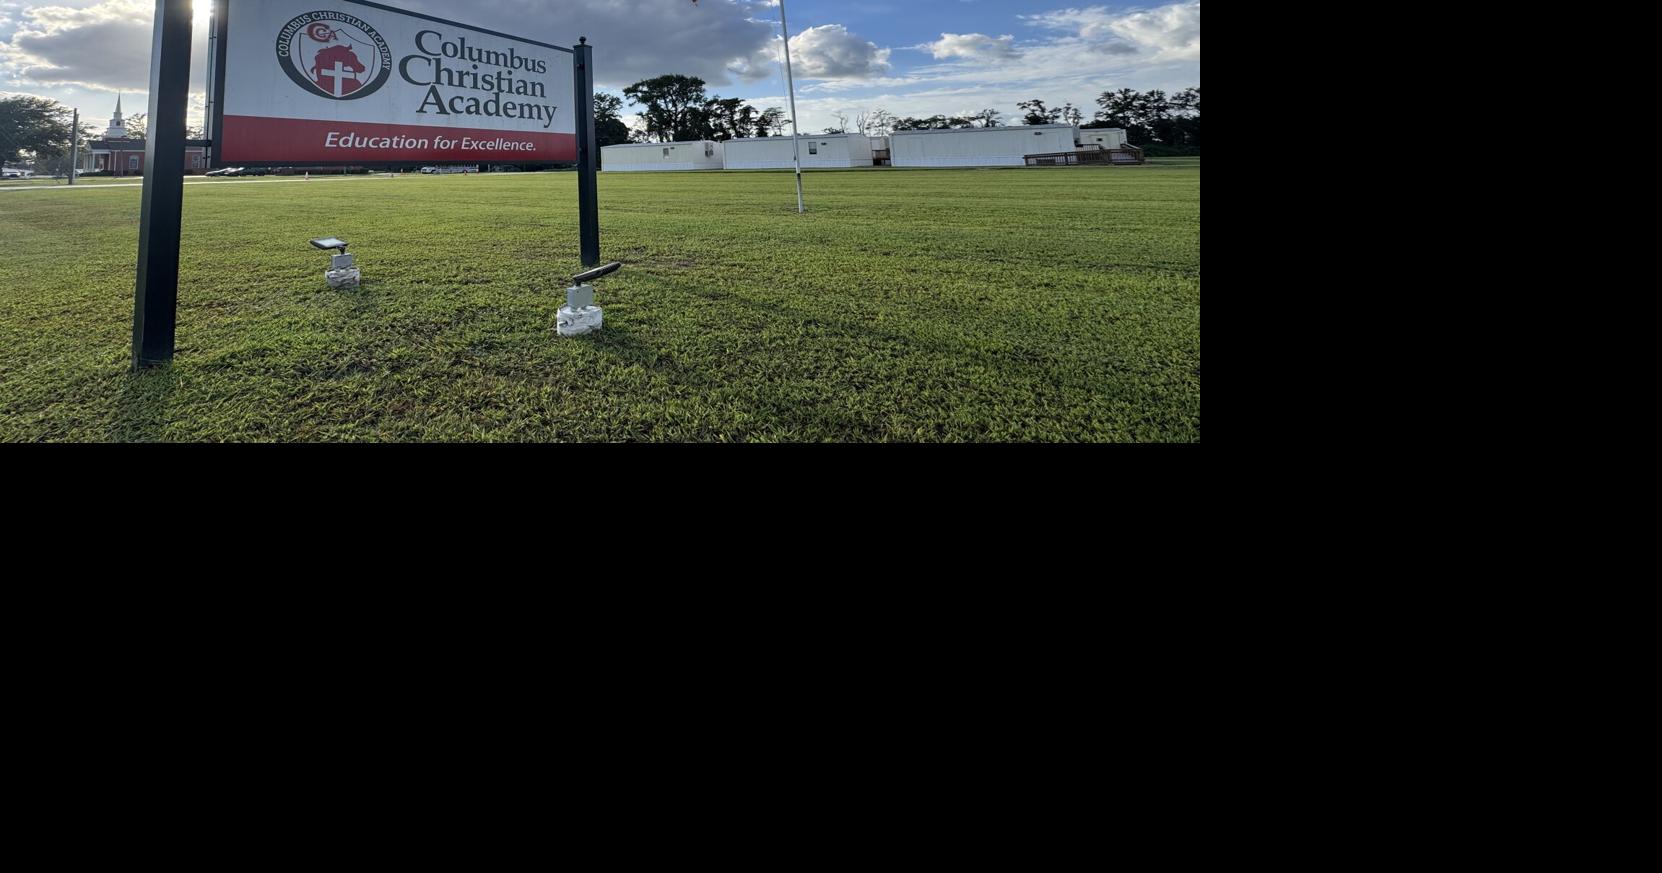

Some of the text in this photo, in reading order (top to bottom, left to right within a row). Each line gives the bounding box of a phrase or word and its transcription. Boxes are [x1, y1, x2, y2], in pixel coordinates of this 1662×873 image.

[278, 11, 392, 71] COLUMBUS CHRISTIAN ACADEMY
[414, 29, 547, 74] Columbus
[399, 54, 546, 99] Christian
[415, 85, 557, 128] Academy
[324, 131, 537, 152] Education for Excellence.
